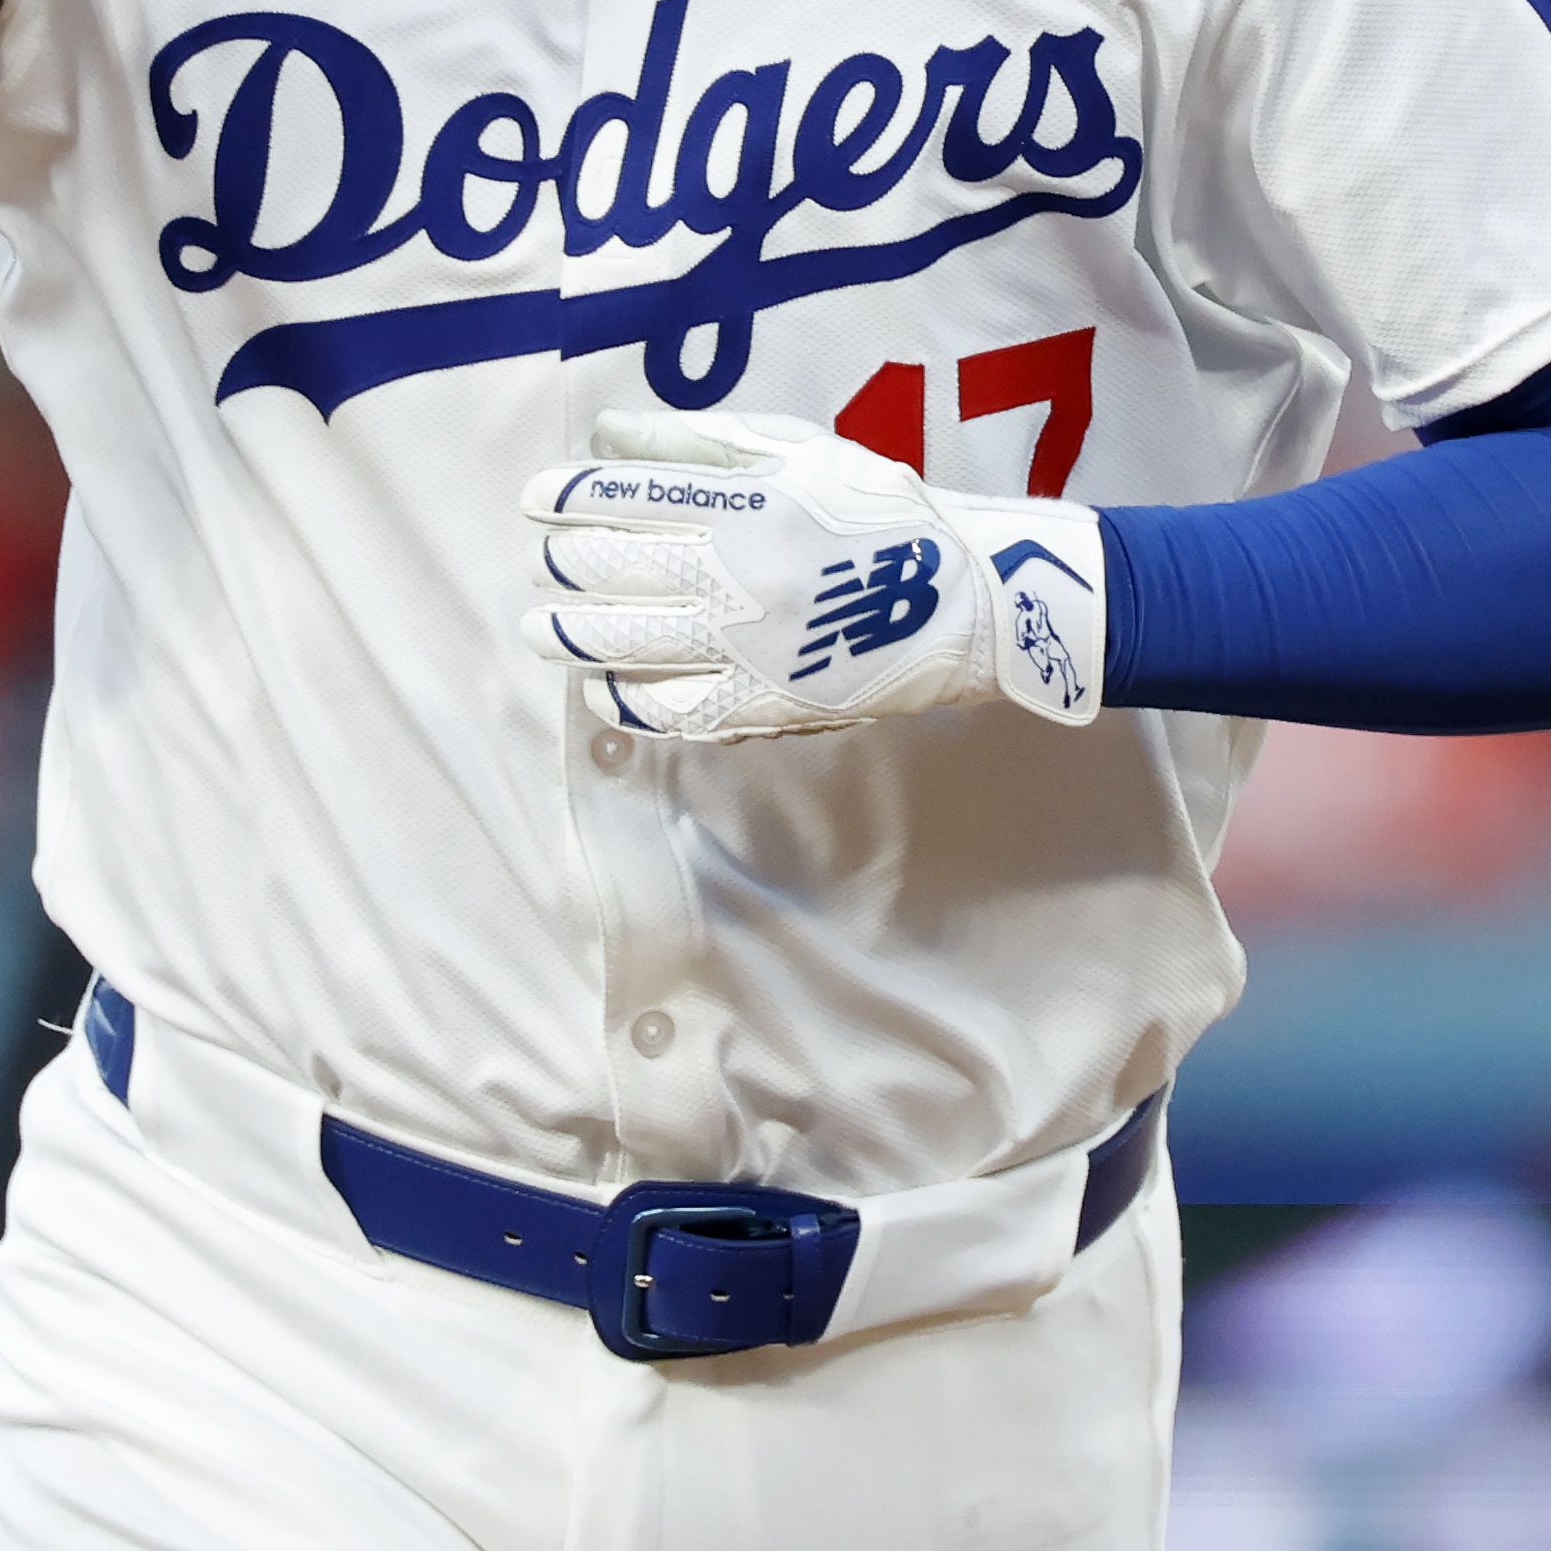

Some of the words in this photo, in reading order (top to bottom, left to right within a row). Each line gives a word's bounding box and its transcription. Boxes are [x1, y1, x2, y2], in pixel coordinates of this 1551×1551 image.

[833, 326, 1096, 499] 17
[590, 479, 641, 499] new
[647, 478, 767, 511] balance
